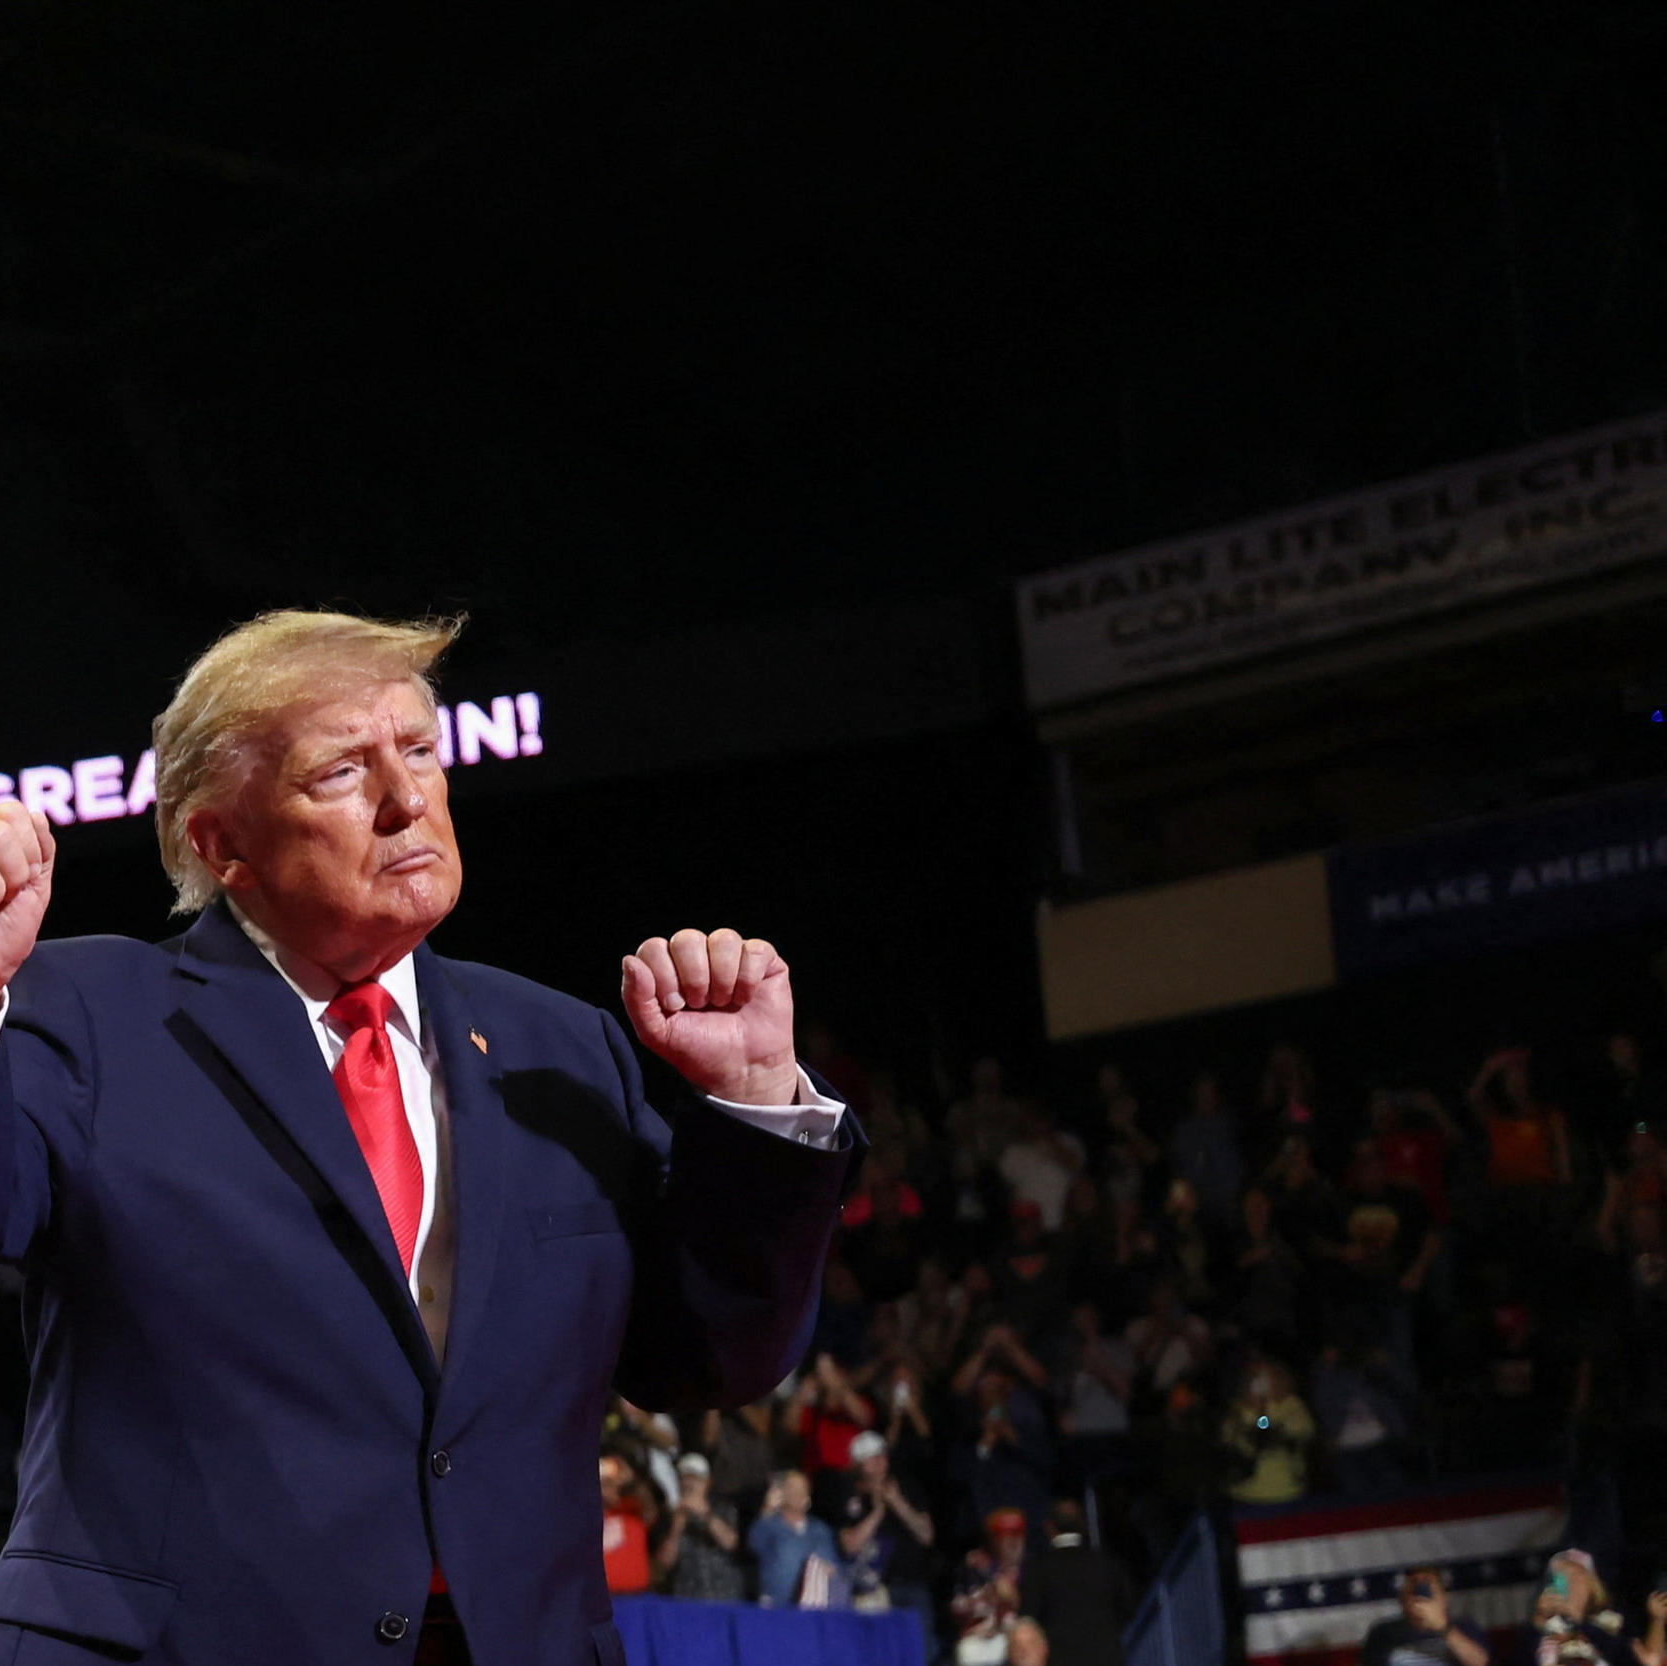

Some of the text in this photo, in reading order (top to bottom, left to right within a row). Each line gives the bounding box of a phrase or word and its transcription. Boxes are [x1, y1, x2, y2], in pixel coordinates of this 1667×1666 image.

[1031, 549, 1207, 622] MAIN
[1228, 508, 1368, 573] LITE
[1388, 430, 1667, 530] ELECTR
[1107, 528, 1460, 647] COMPANY
[437, 690, 544, 769] IN!
[1368, 871, 1492, 923] MAKE
